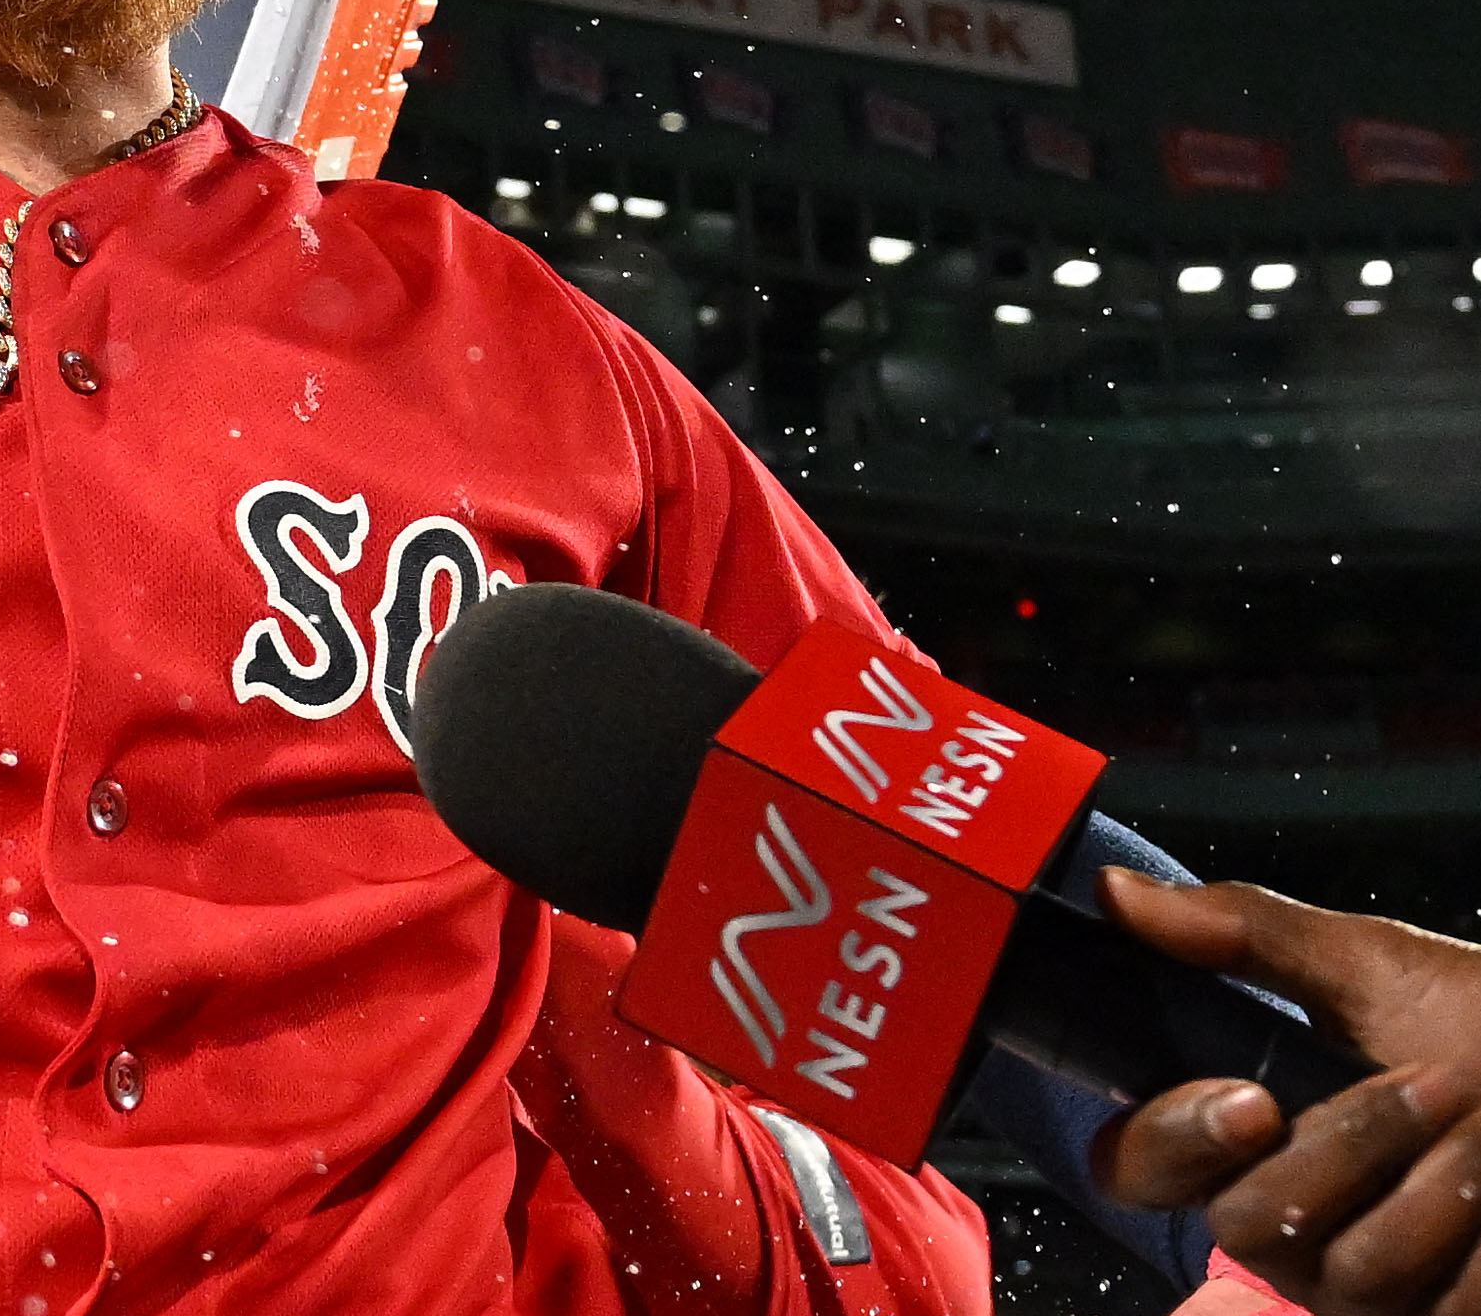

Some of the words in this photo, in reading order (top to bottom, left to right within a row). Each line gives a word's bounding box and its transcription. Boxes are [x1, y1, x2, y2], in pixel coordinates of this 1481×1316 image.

[231, 477, 524, 759] SO
[898, 709, 1028, 839] NESN
[796, 866, 932, 1100] NESN
